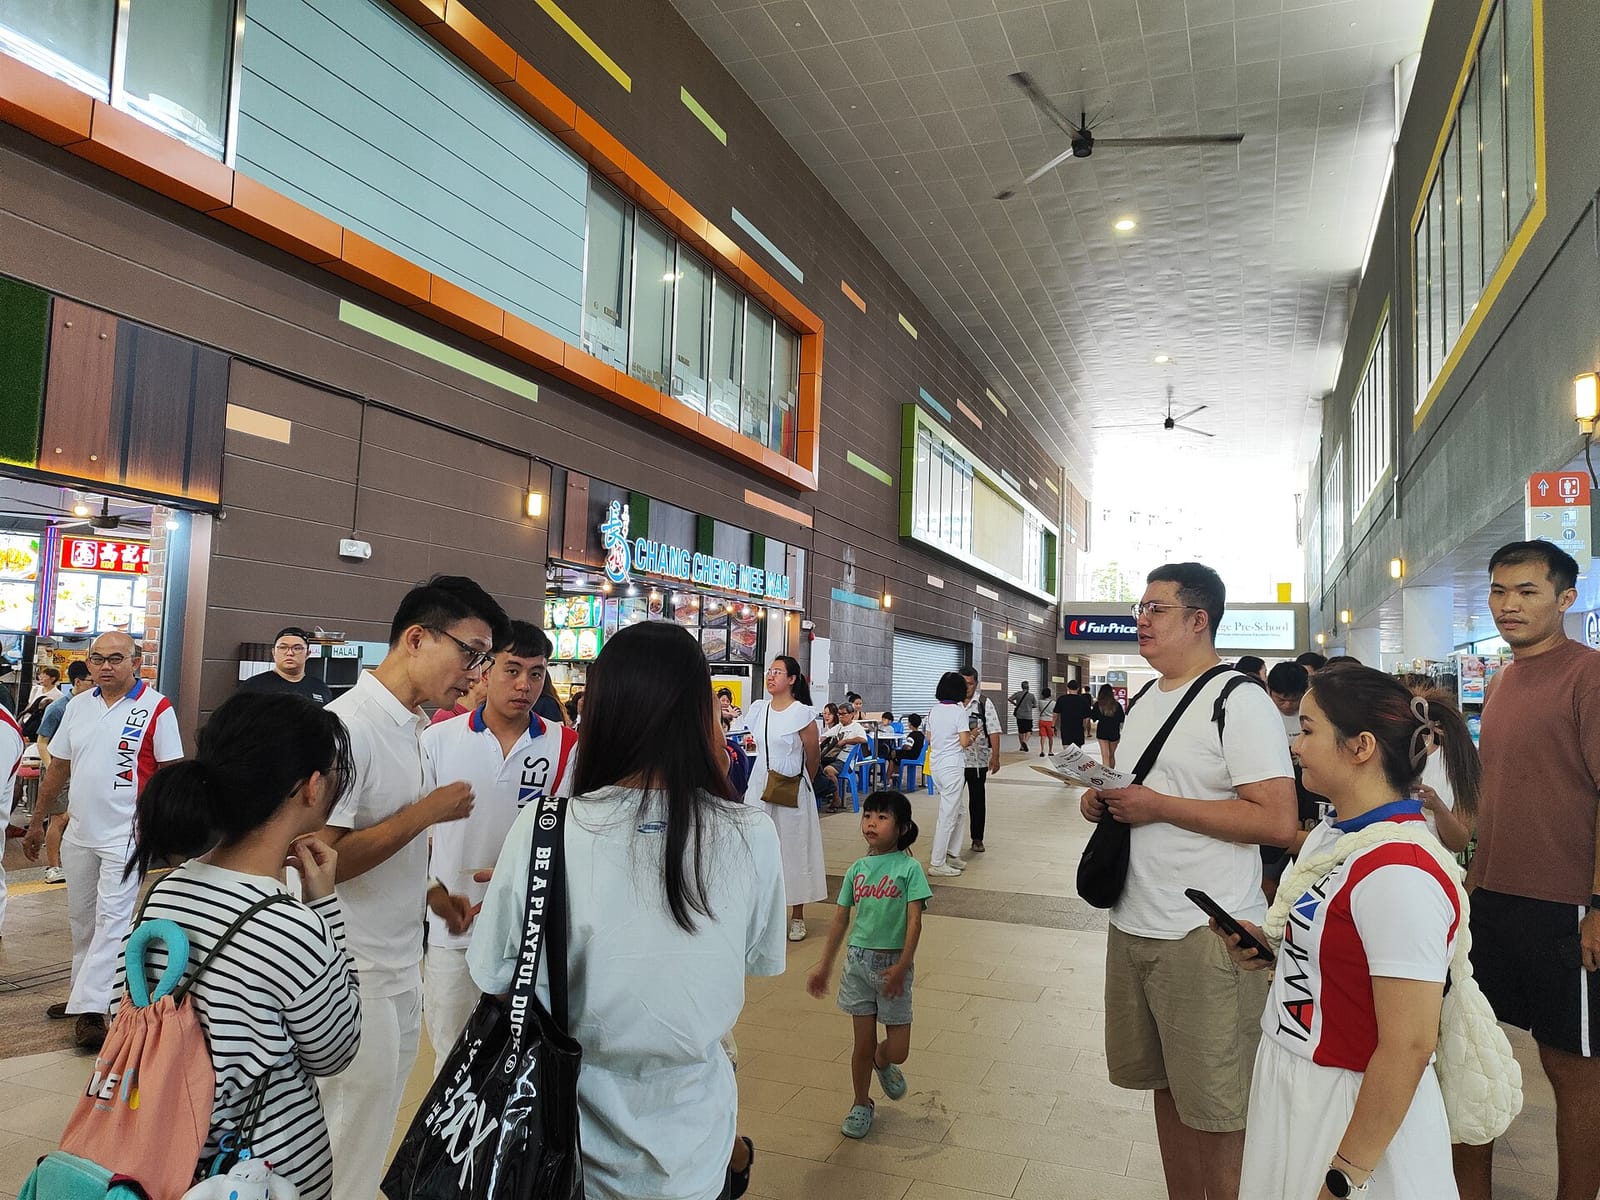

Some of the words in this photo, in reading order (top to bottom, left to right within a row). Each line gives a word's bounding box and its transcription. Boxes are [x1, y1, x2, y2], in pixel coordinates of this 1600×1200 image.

[635, 537, 691, 580] CHANG
[692, 552, 737, 589] CHENG
[739, 564, 764, 596] MEE
[765, 570, 789, 600] WAH
[1087, 622, 1137, 634] FairPrice
[1234, 621, 1289, 632] Pre-School
[333, 647, 357, 656] HALAL
[113, 707, 149, 790] TAMPINES
[534, 847, 552, 871] BE
[532, 876, 547, 892] A
[853, 873, 903, 903] Barbie
[515, 896, 545, 990] PLAYFUL
[510, 995, 529, 1053] DUCK
